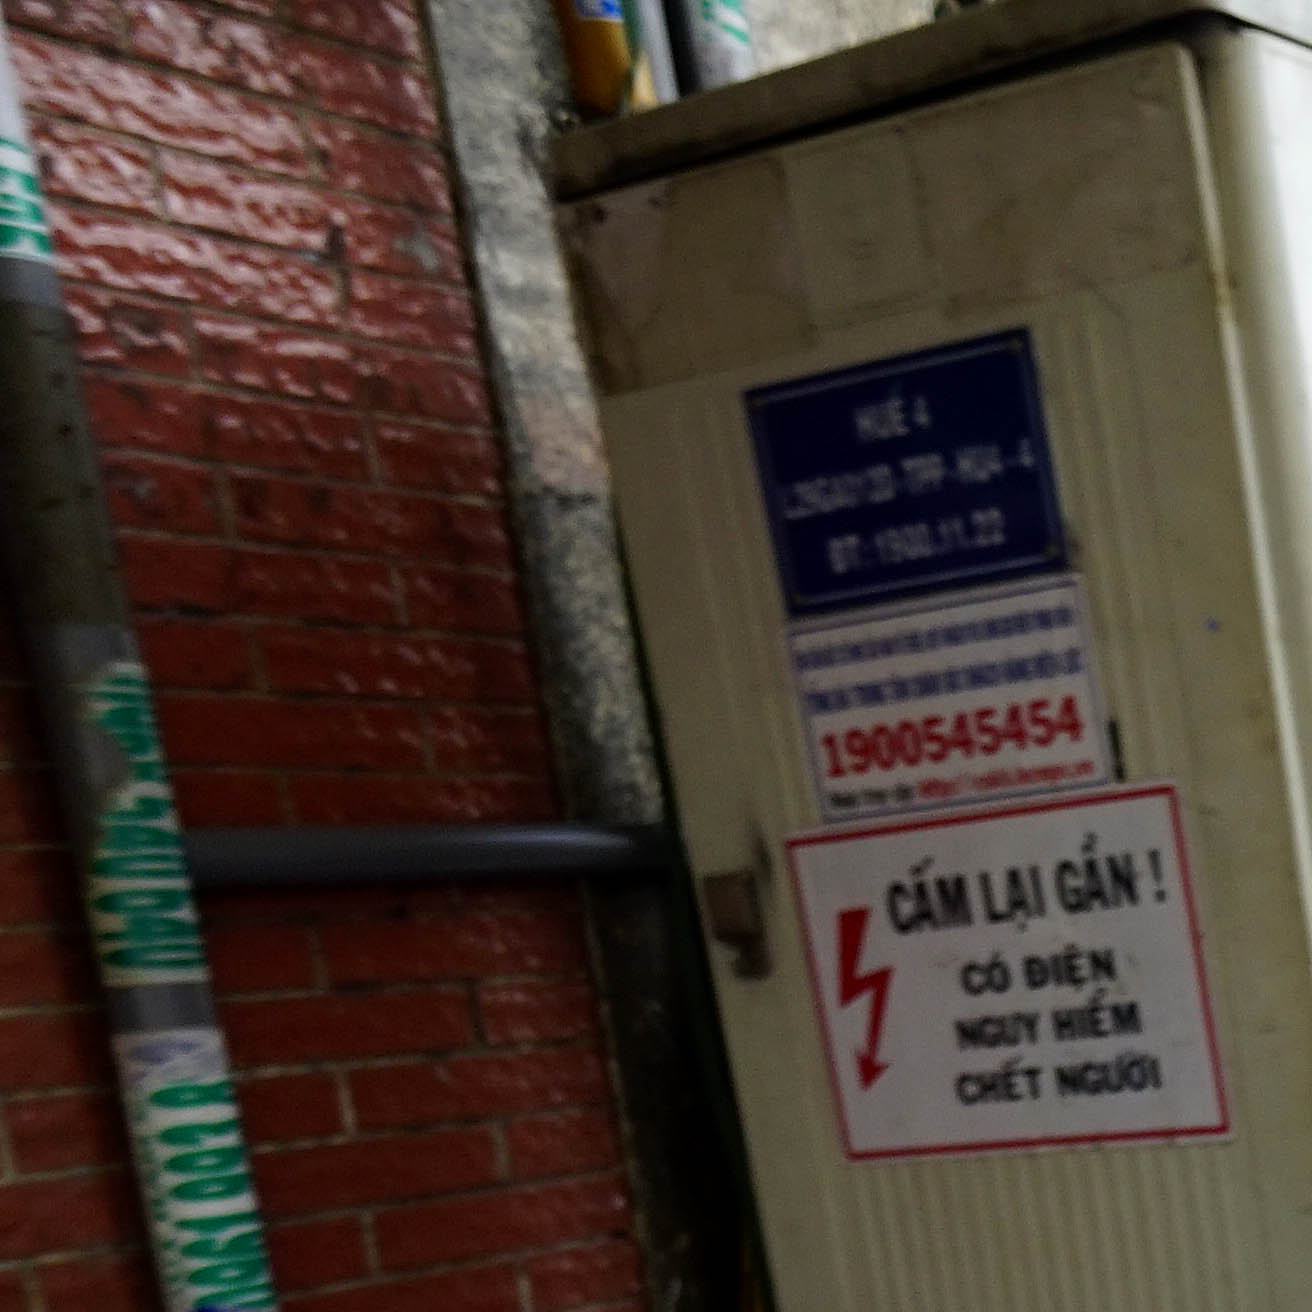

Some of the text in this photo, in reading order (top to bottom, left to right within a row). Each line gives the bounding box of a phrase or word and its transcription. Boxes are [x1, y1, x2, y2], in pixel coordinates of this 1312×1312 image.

[821, 696, 1084, 778] 1900545454
[886, 856, 972, 934] CẤM
[978, 865, 1047, 931] LẠI
[960, 951, 1012, 995] CÓ
[954, 1012, 1040, 1050] NGUY
[954, 1056, 1043, 1105] CHẾT
